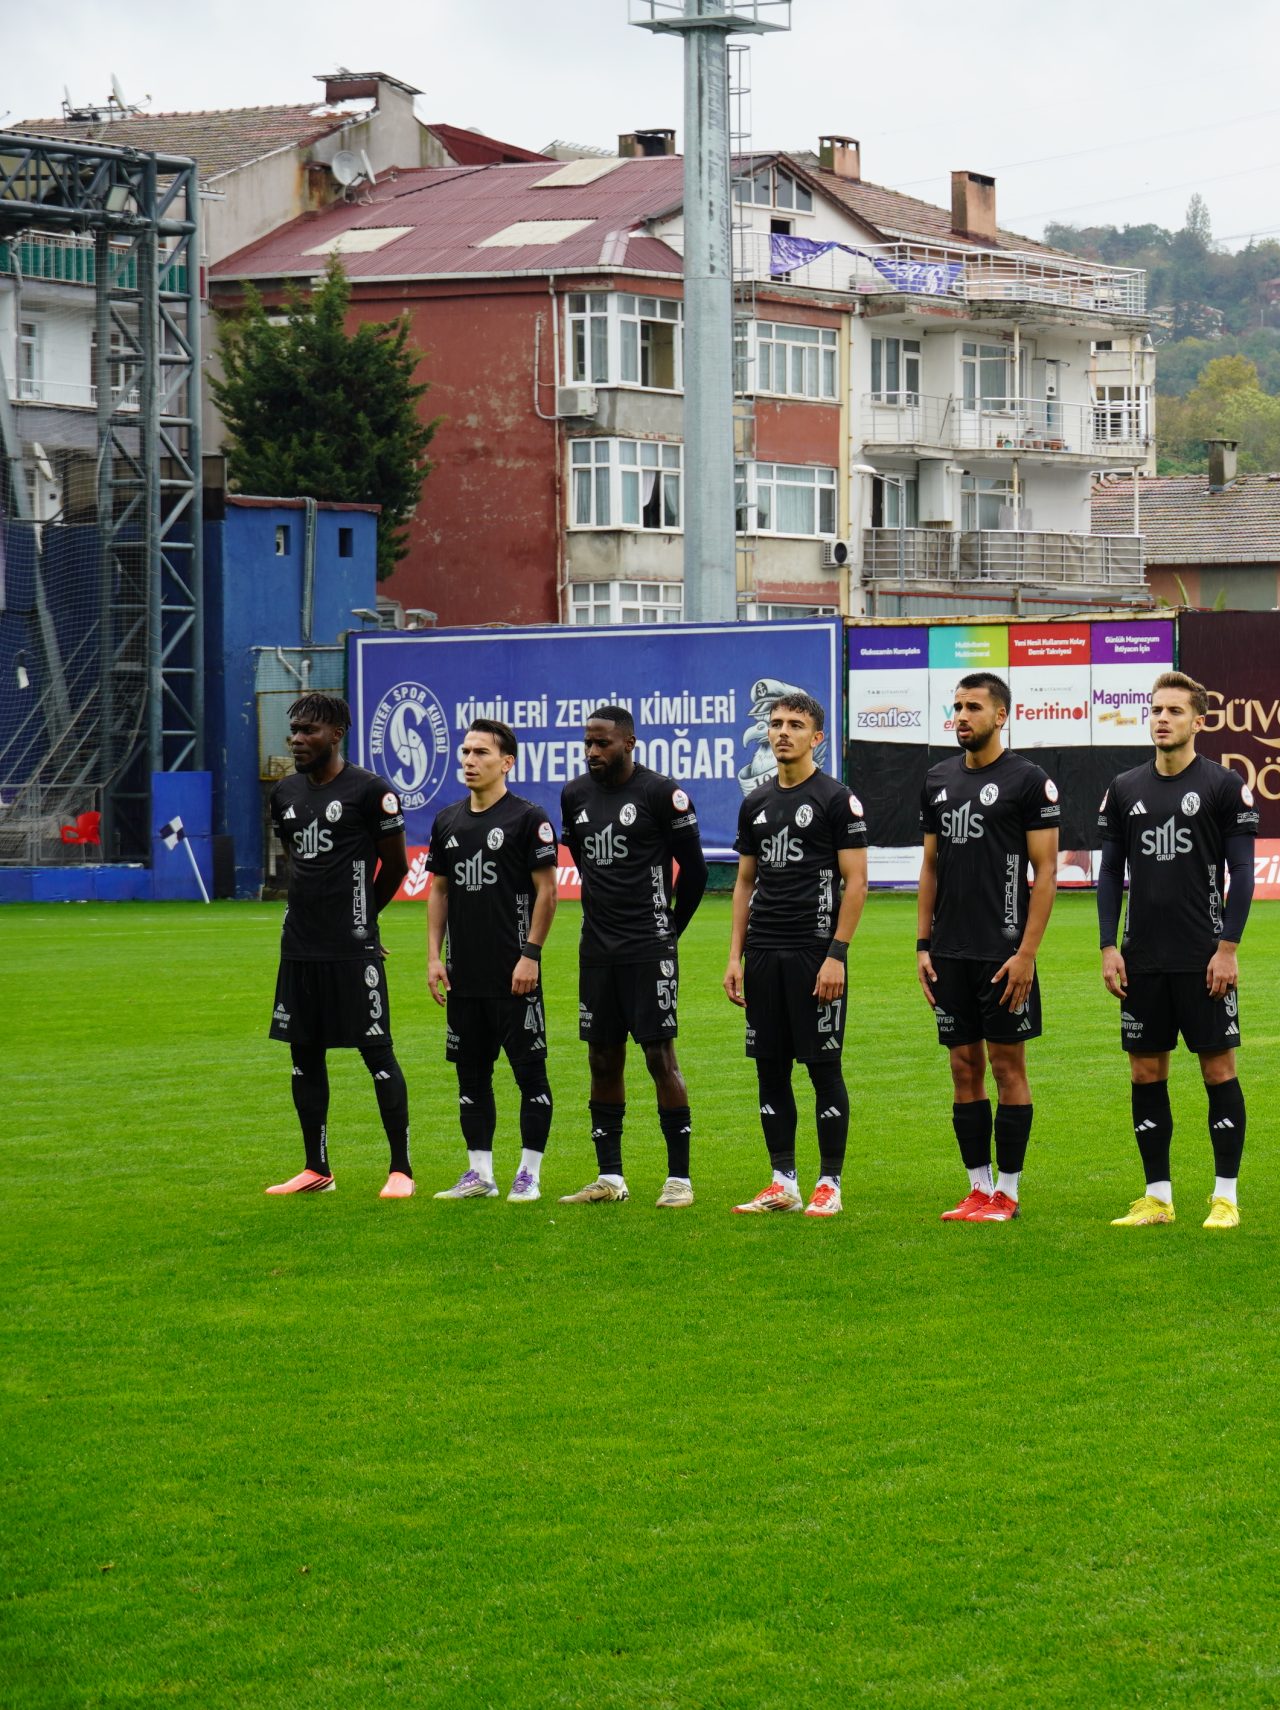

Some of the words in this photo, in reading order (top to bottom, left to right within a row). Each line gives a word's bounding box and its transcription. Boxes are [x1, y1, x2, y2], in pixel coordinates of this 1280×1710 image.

[393, 686, 427, 703] SPOR
[456, 694, 548, 729] KİMİLERİ
[640, 689, 735, 725] KİMİLERİ
[858, 707, 921, 728] zenflex
[1015, 701, 1088, 721] Feritinol
[372, 702, 392, 755] SARIYER
[1157, 854, 1176, 862] GRUP
[353, 860, 361, 925] INTRALINE
[1005, 853, 1014, 924] INTRALINE
[369, 989, 382, 1019] 3
[524, 1002, 544, 1034] 41
[817, 1000, 842, 1032] 27
